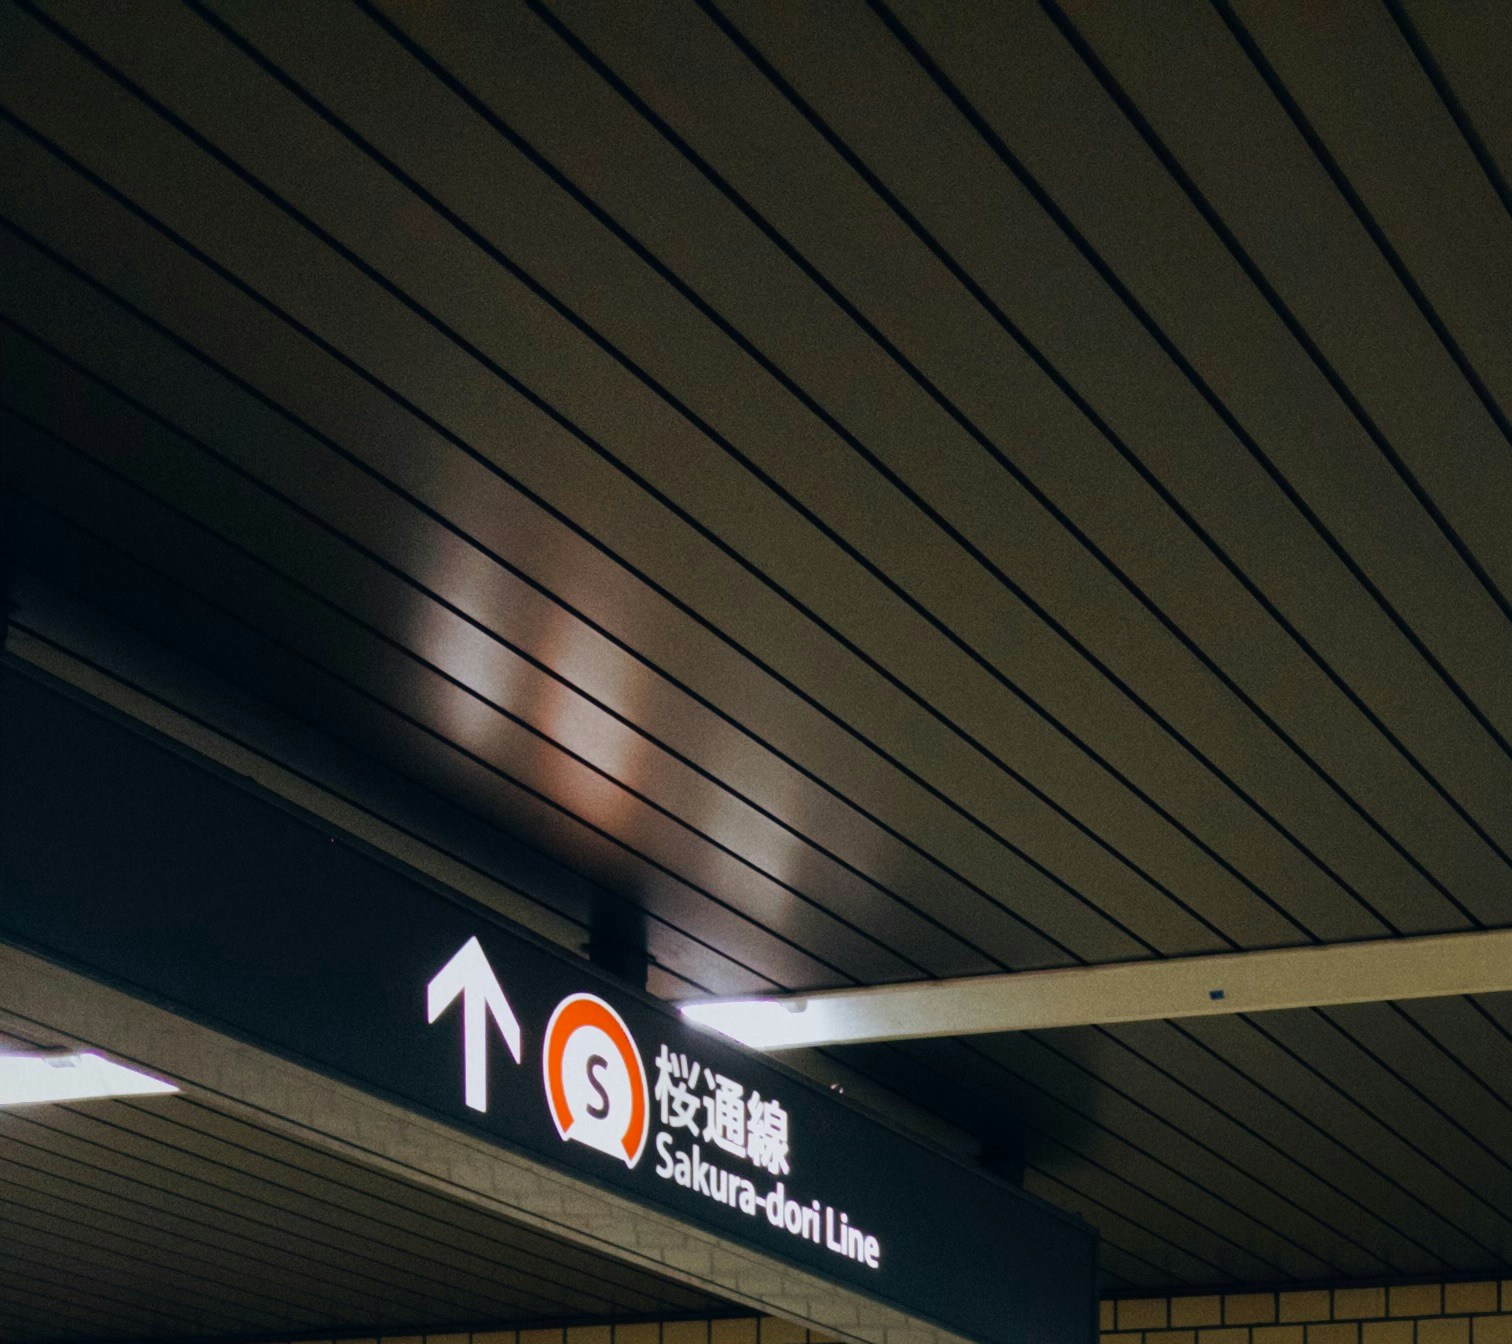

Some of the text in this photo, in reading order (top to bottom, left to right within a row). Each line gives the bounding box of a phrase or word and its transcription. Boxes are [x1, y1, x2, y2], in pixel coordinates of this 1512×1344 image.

[586, 1054, 610, 1120] S
[655, 1044, 790, 1175] 桜通線
[655, 1132, 880, 1269] Sakura-dori Line
